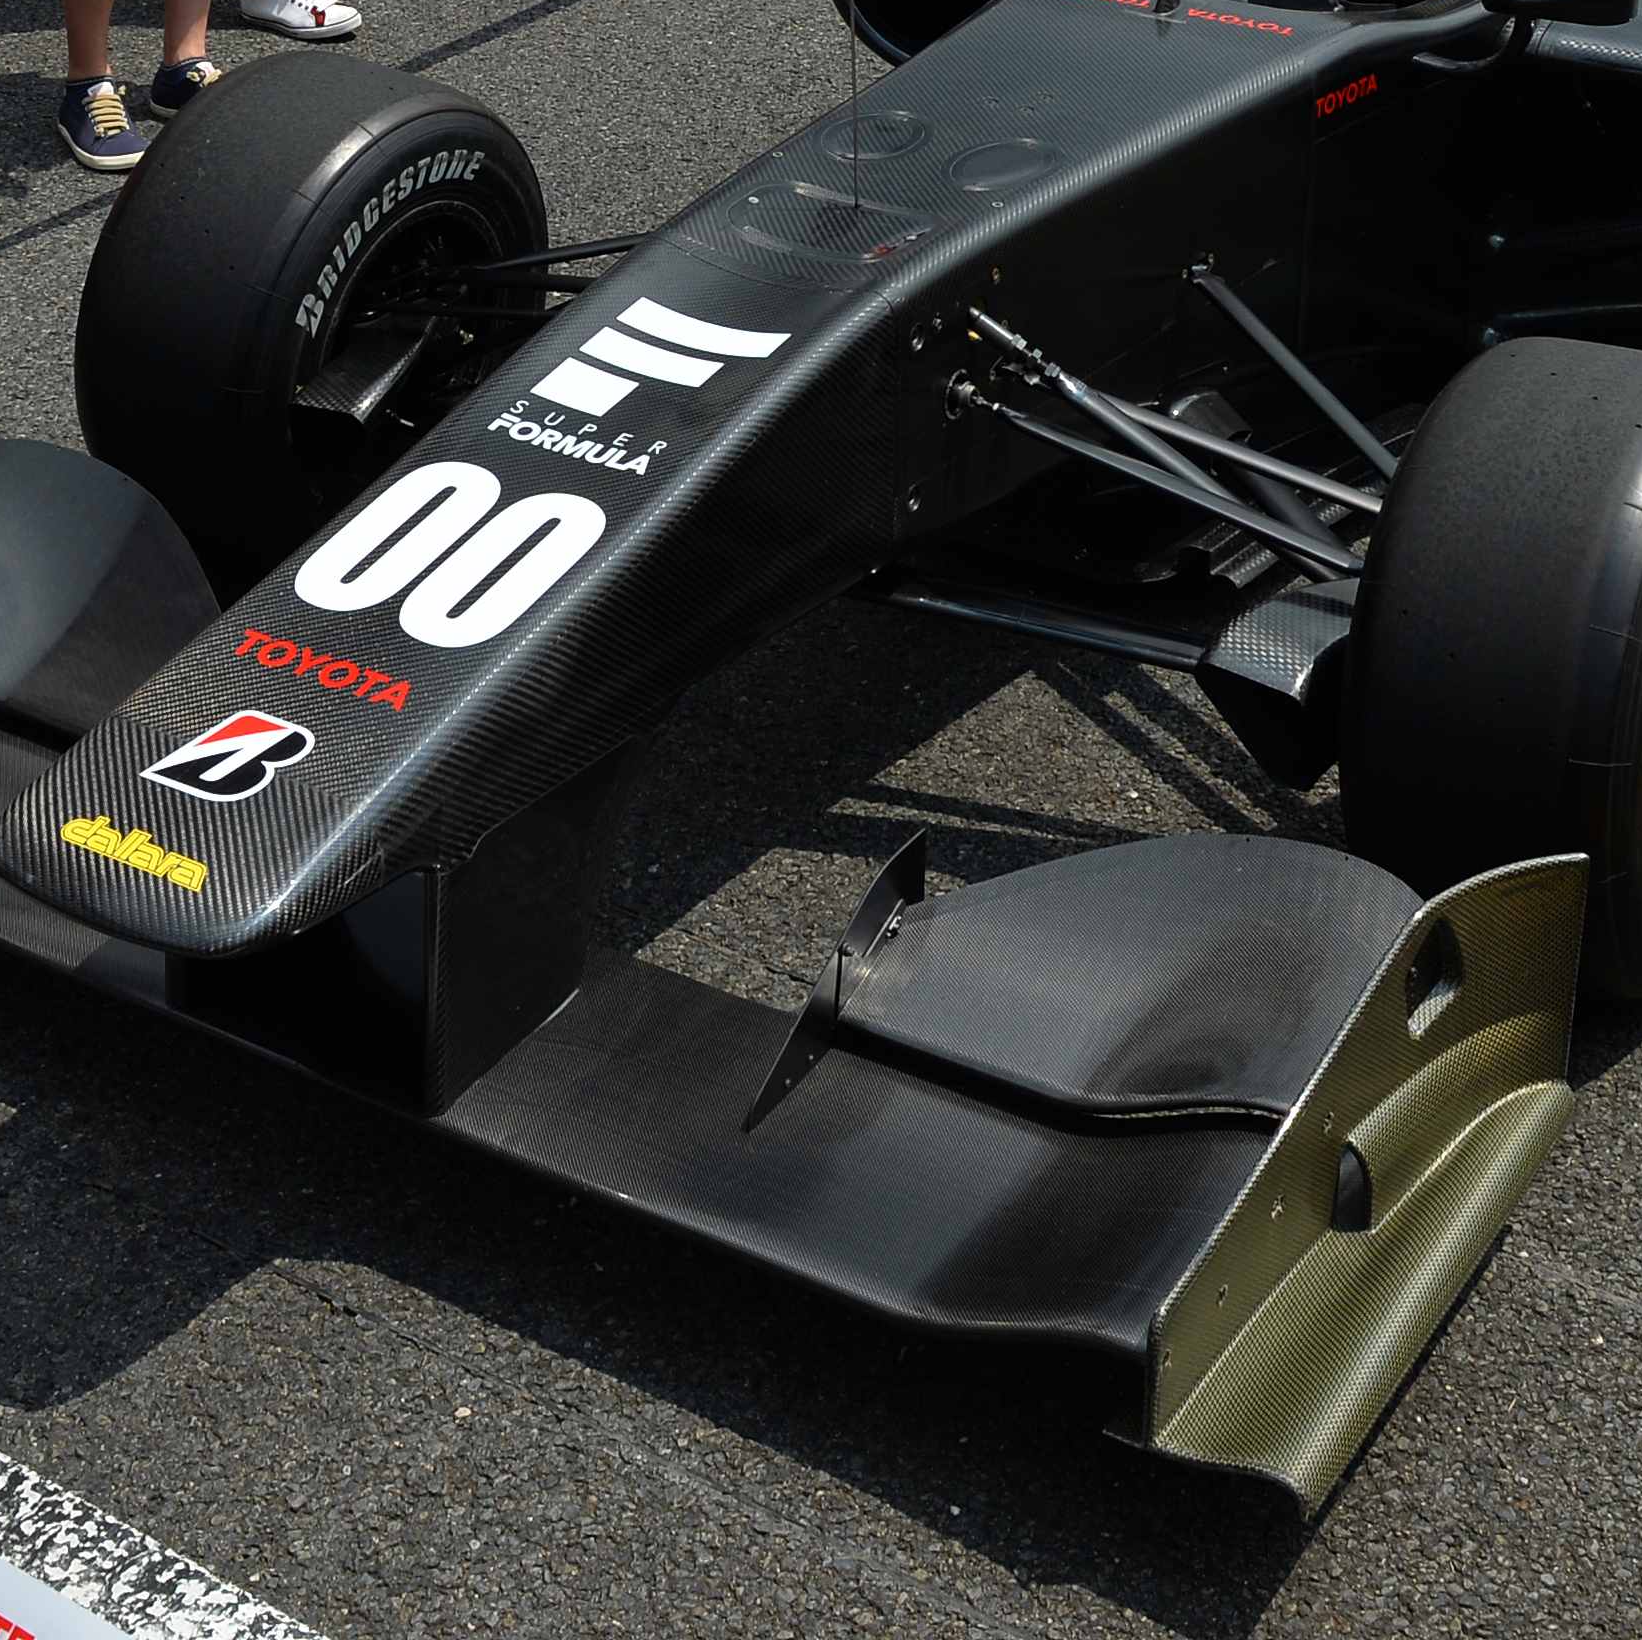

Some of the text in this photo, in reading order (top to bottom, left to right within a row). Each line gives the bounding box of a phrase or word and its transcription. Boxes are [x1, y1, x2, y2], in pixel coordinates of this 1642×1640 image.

[1188, 8, 1293, 36] TOYOTA
[1315, 73, 1378, 118] TOYOTA
[294, 150, 485, 340] BRIDGESTONE
[486, 412, 653, 477] FORMULA
[509, 399, 671, 455] SUPER
[294, 461, 607, 649] 00
[234, 627, 419, 712] TOYOTA
[60, 815, 210, 894] dallara
